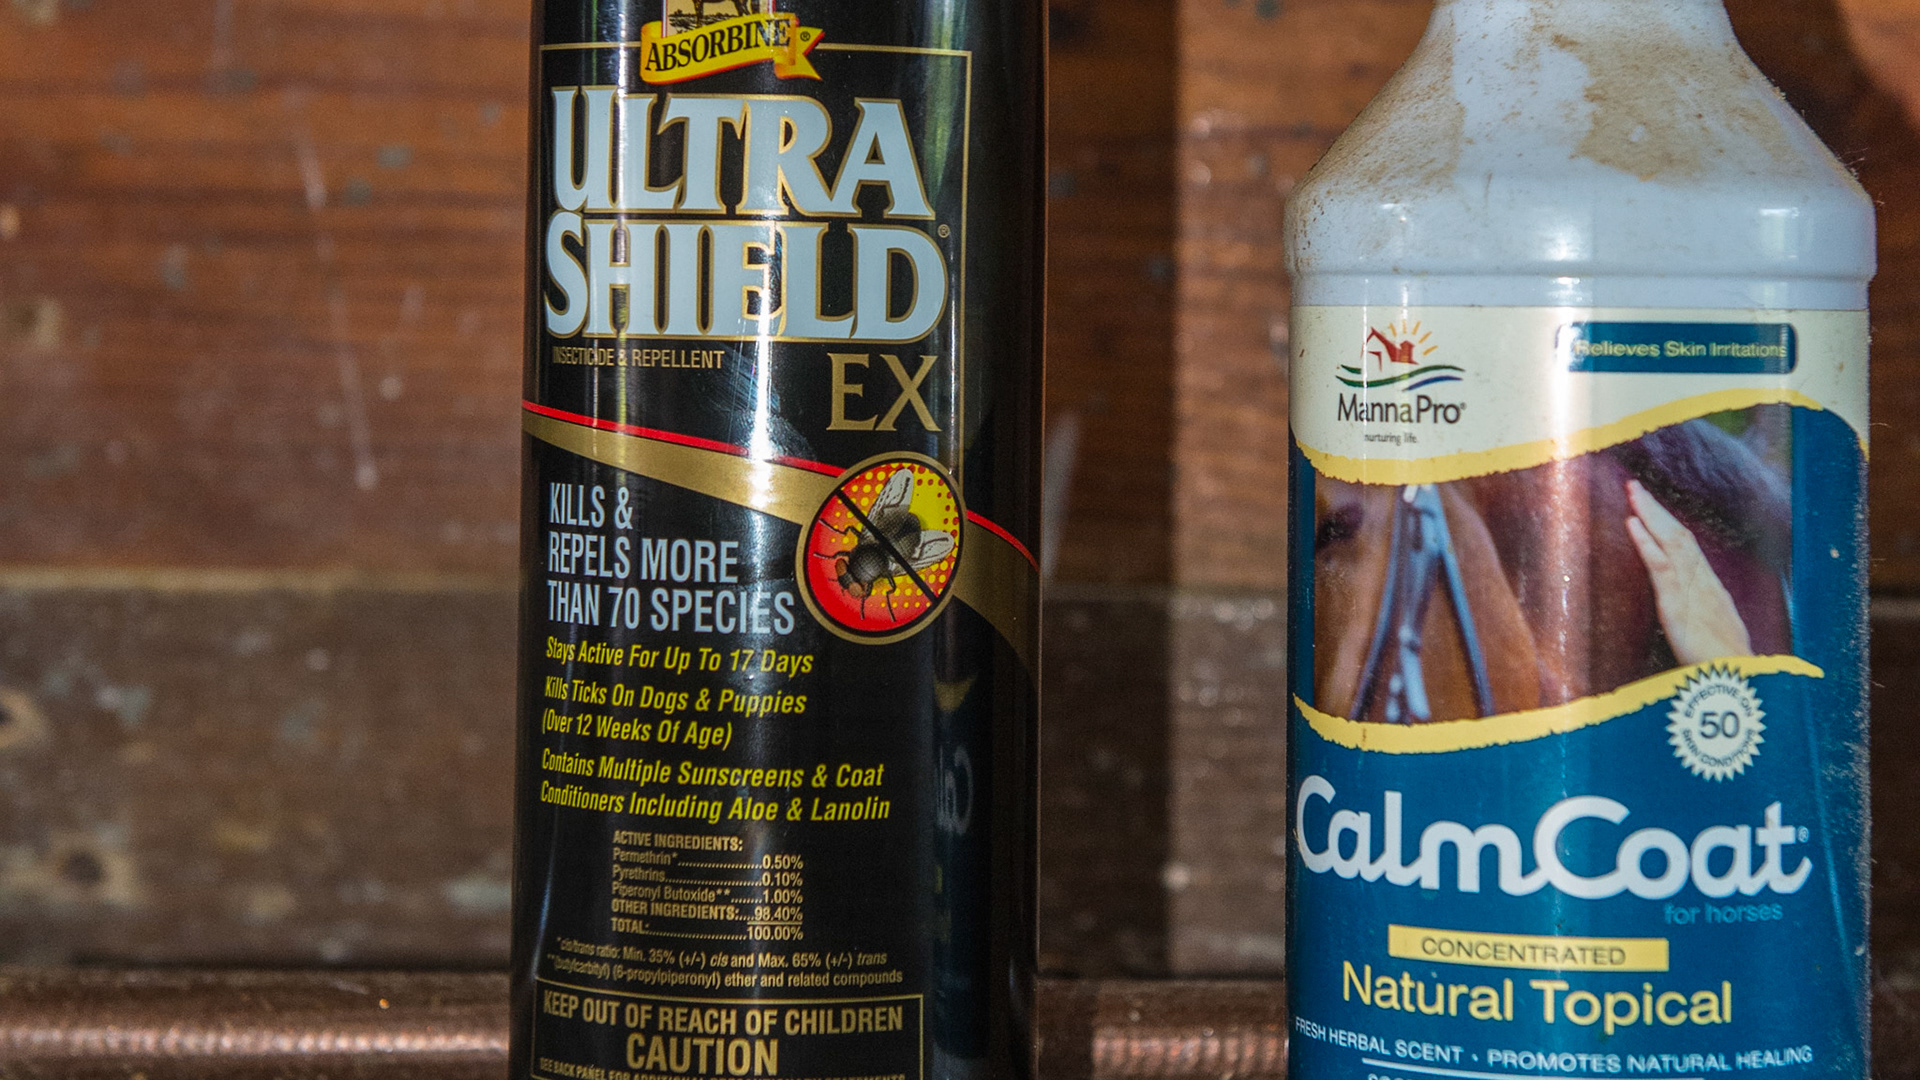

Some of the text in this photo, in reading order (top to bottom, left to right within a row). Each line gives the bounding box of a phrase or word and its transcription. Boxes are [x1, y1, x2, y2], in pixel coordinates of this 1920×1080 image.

[644, 18, 791, 72] ABSORBINE
[551, 86, 936, 220] ULTRA
[552, 346, 725, 369] INSECTICIDE & REPELLENT
[1575, 340, 1788, 359] Relieves Skin Irritations
[827, 352, 941, 431] EX
[1364, 431, 1401, 446] nurturing
[549, 482, 633, 530] KILLS &
[548, 531, 739, 583] REPELS MORE
[548, 580, 795, 636] THAN 70 SPECIES
[546, 636, 814, 678] Stays Active For Up To 17 Days
[545, 675, 808, 718] Kills Ticks On Dogs & Puppies
[1685, 684, 1740, 718] EFFECTIVE
[542, 708, 733, 751] (Over 12 Weeks Of Age)
[1700, 711, 1740, 739] 50
[542, 748, 884, 788] Contains Multiple Sunscreens & Coat
[541, 780, 890, 825] Conditioners Including Aloe & Lanolin
[612, 830, 743, 851] ACTIVE INGREDIENTS:
[611, 898, 648, 915] OTHER
[612, 881, 661, 901] Piperonyl
[747, 925, 804, 941] 100.00%
[1664, 902, 1784, 923] for horses
[623, 945, 646, 962] Min.
[649, 948, 675, 965] 35%
[678, 951, 706, 970] (+/-)
[710, 953, 729, 968] cis
[731, 952, 754, 968] and
[758, 953, 789, 968] Max.
[792, 952, 821, 967] 65%
[825, 953, 853, 970] (+/-)
[857, 952, 888, 967] trans
[1420, 937, 1627, 966] CONCENTRATED
[612, 963, 721, 990] (6-propylpiperonyl)
[724, 970, 757, 988] ether
[760, 971, 784, 988] and
[787, 972, 830, 987] related
[833, 968, 903, 988] compounds
[543, 988, 903, 1036] KEEP OUT OF REACH OF CHILDREN
[1342, 961, 1733, 1036] Natural Topical
[626, 1032, 779, 1077] CAUTION
[1295, 1016, 1814, 1074] FRESH HERBAL SCENT PROMOTES NATURAL HEALING
